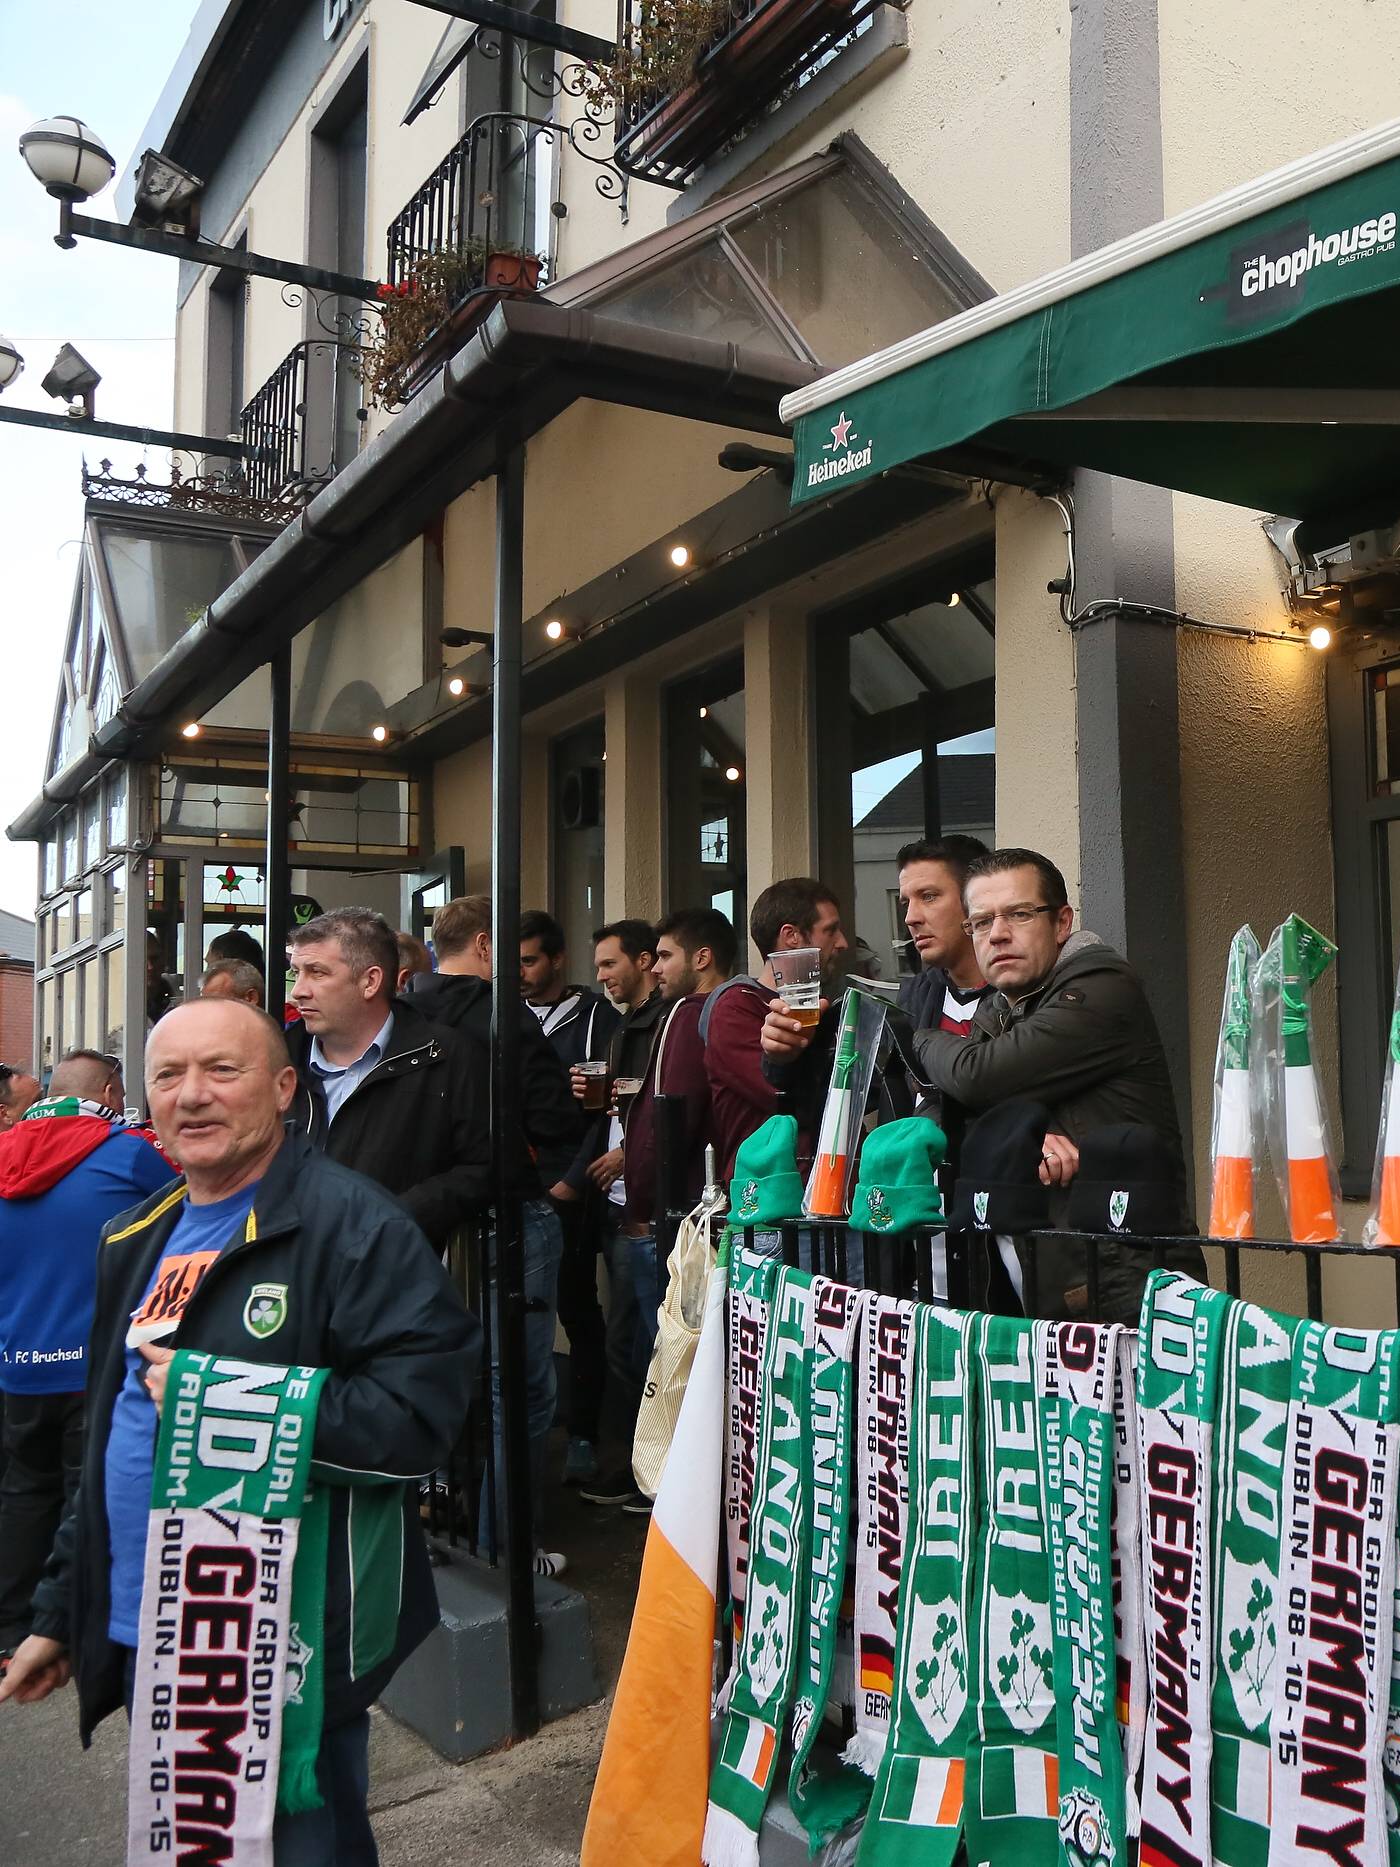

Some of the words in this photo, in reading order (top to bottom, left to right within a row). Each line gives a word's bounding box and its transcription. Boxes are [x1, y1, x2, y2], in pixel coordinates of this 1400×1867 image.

[1241, 212, 1397, 297] chophouse
[1243, 257, 1259, 269] THE
[1337, 248, 1375, 267] GASTRO
[1376, 241, 1395, 255] PUB
[807, 447, 872, 486] Heineken
[15, 1350, 29, 1364] FC
[32, 1345, 83, 1364] Bruchsal
[1236, 1303, 1291, 1540] AND
[866, 1415, 878, 1549] 08-10-15
[926, 1306, 964, 1562] IREL
[1049, 1502, 1069, 1638] EUROPE
[1088, 1597, 1107, 1713] AVIVA
[1147, 1442, 1198, 1837] GERMANY
[1278, 1586, 1307, 1767] 08-10-15
[1295, 1447, 1370, 1867] GERMANY
[149, 1684, 173, 1852] 08-10-15
